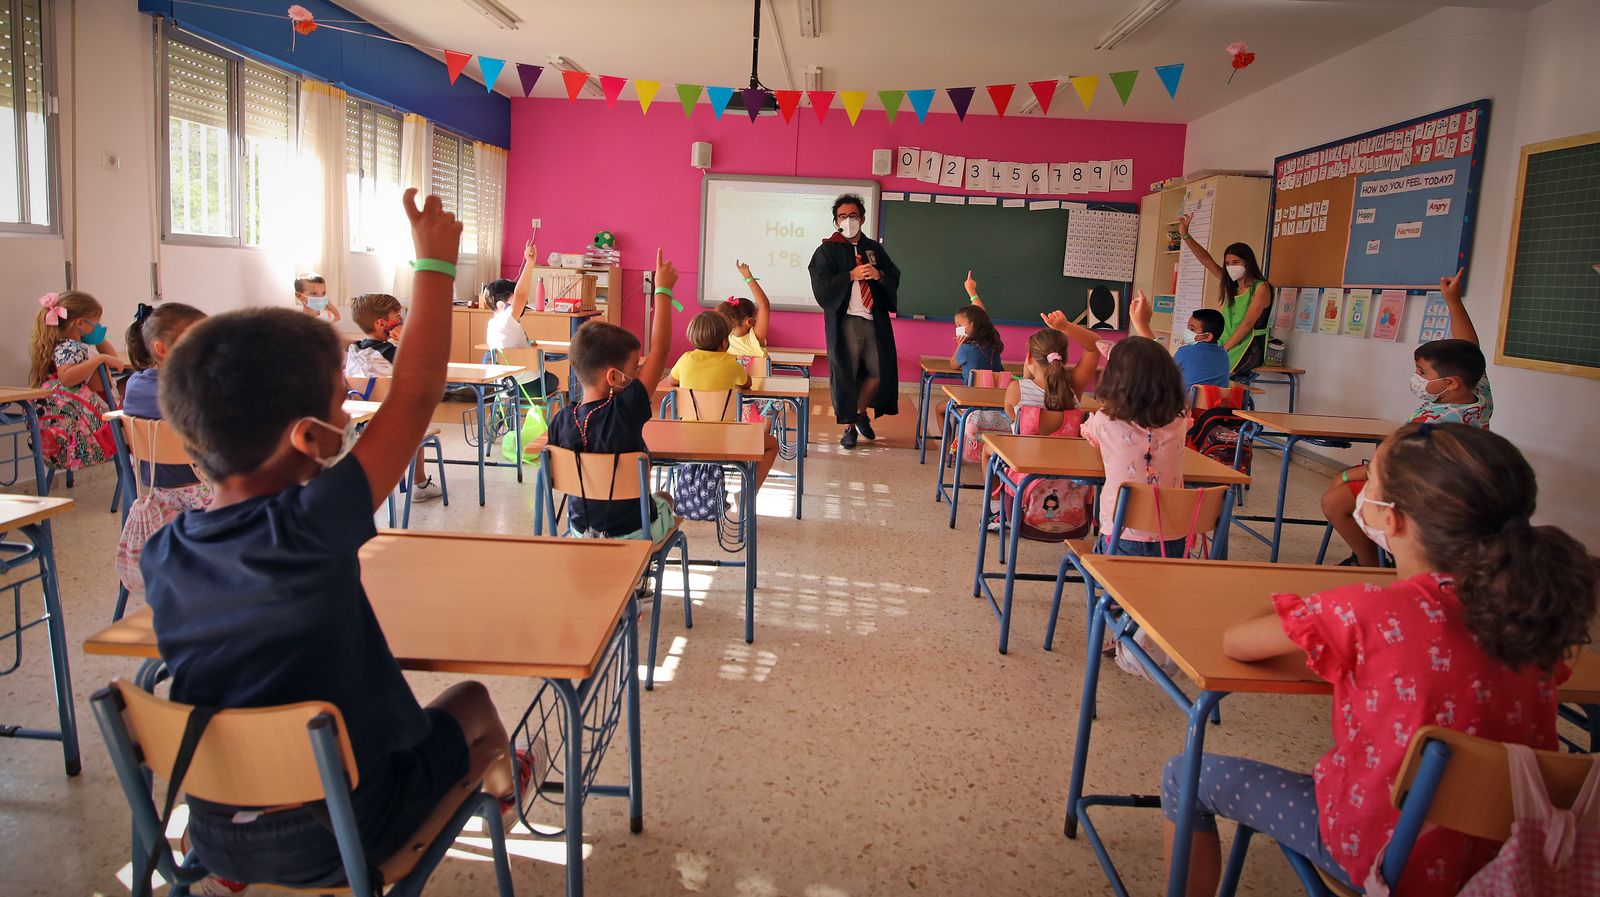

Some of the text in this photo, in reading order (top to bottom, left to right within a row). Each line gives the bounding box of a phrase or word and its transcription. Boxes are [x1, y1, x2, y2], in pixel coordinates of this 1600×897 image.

[1463, 135, 1470, 149] S
[902, 152, 1128, 182] 0 1 2 3 4 5 6 7 8 9 10
[1362, 174, 1453, 194] HOW DO YOU FEEL TODAY?
[1429, 202, 1448, 212] Angry
[1357, 211, 1373, 220] Happy
[765, 220, 805, 238] Hola
[1396, 226, 1420, 236] Nervous
[1367, 243, 1378, 251] Sad
